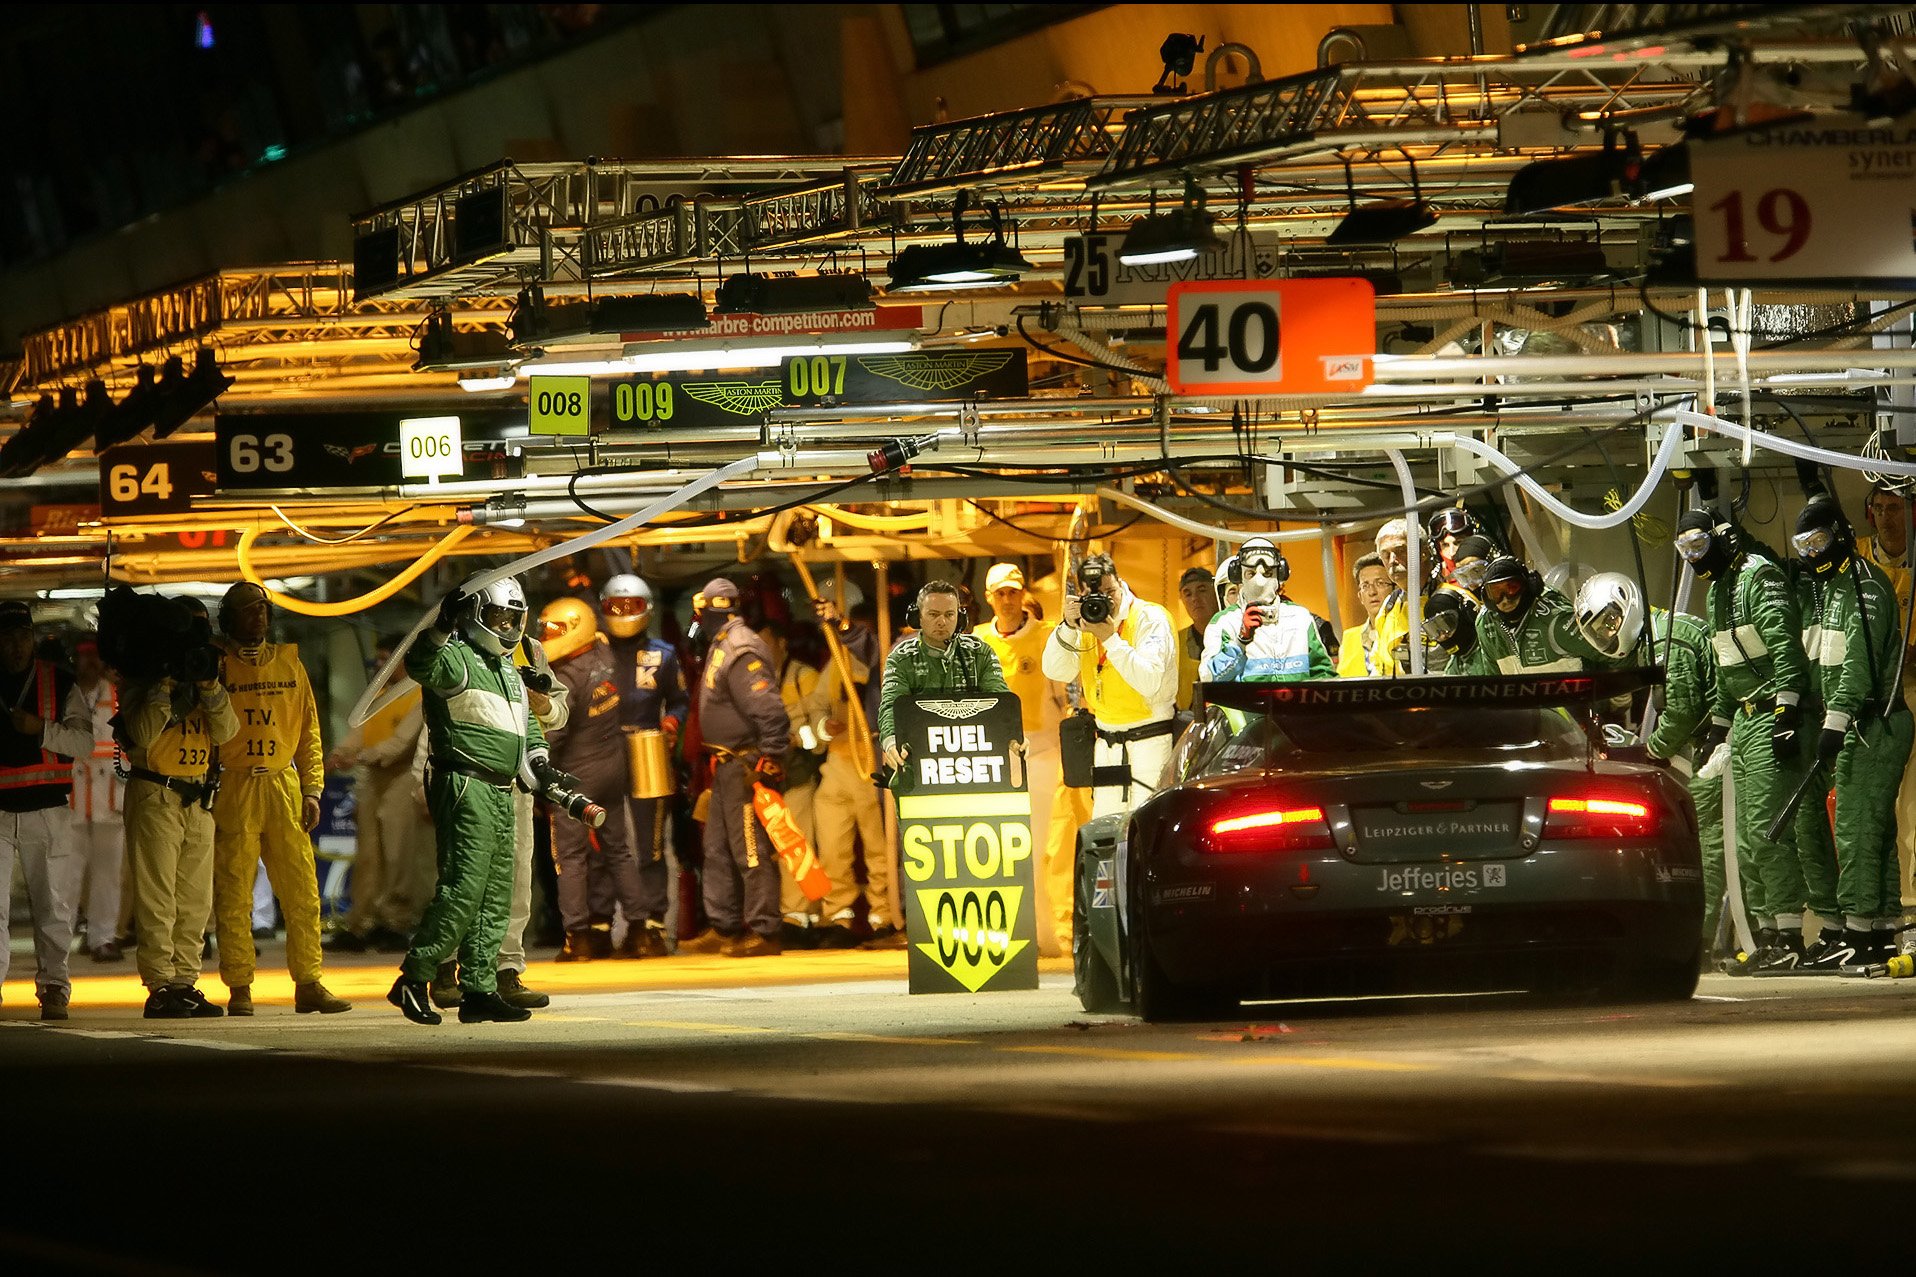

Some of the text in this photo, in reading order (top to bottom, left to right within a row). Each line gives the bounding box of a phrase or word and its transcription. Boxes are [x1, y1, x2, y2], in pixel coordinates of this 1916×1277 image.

[1710, 188, 1812, 263] 19
[1064, 237, 1108, 297] 25
[1178, 301, 1281, 374] 40
[789, 355, 847, 397] 007
[538, 391, 582, 416] 008
[616, 382, 674, 421] 009
[726, 388, 752, 396] ASTON
[230, 433, 295, 473] 63
[410, 435, 451, 458] 006
[109, 462, 174, 502] 64
[1300, 680, 1591, 704] INTERCONTINENTAL
[243, 708, 276, 726] T.V.
[246, 739, 276, 756] 113
[927, 725, 993, 753] FUEL
[179, 748, 207, 765] 232
[920, 756, 1004, 785] RESET
[1364, 822, 1510, 839] LEIPZIGER & PARTNER
[903, 822, 1032, 882] STOP
[1163, 885, 1211, 898] MICHELIN
[1376, 865, 1478, 891] Jefferies
[937, 890, 1009, 968] 009
